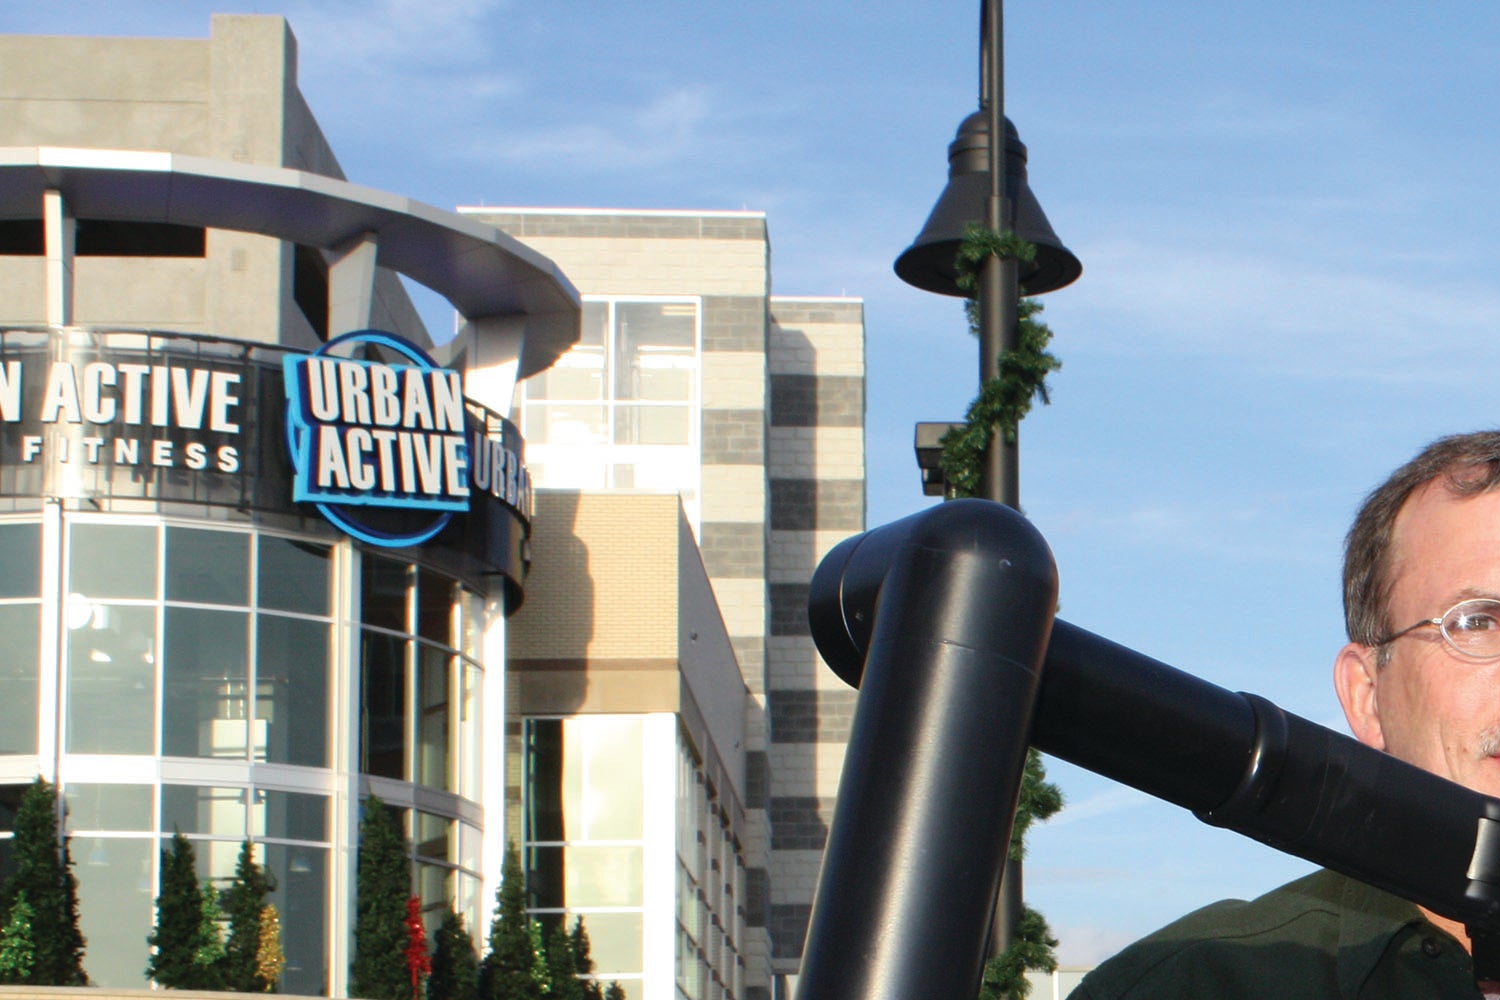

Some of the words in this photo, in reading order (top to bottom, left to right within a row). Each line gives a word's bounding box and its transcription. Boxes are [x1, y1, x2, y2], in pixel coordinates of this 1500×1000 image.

[40, 361, 241, 433] ACTIVE
[307, 358, 464, 432] URBAN
[21, 435, 240, 473] FITNESS
[318, 425, 470, 496] ACTIVE
